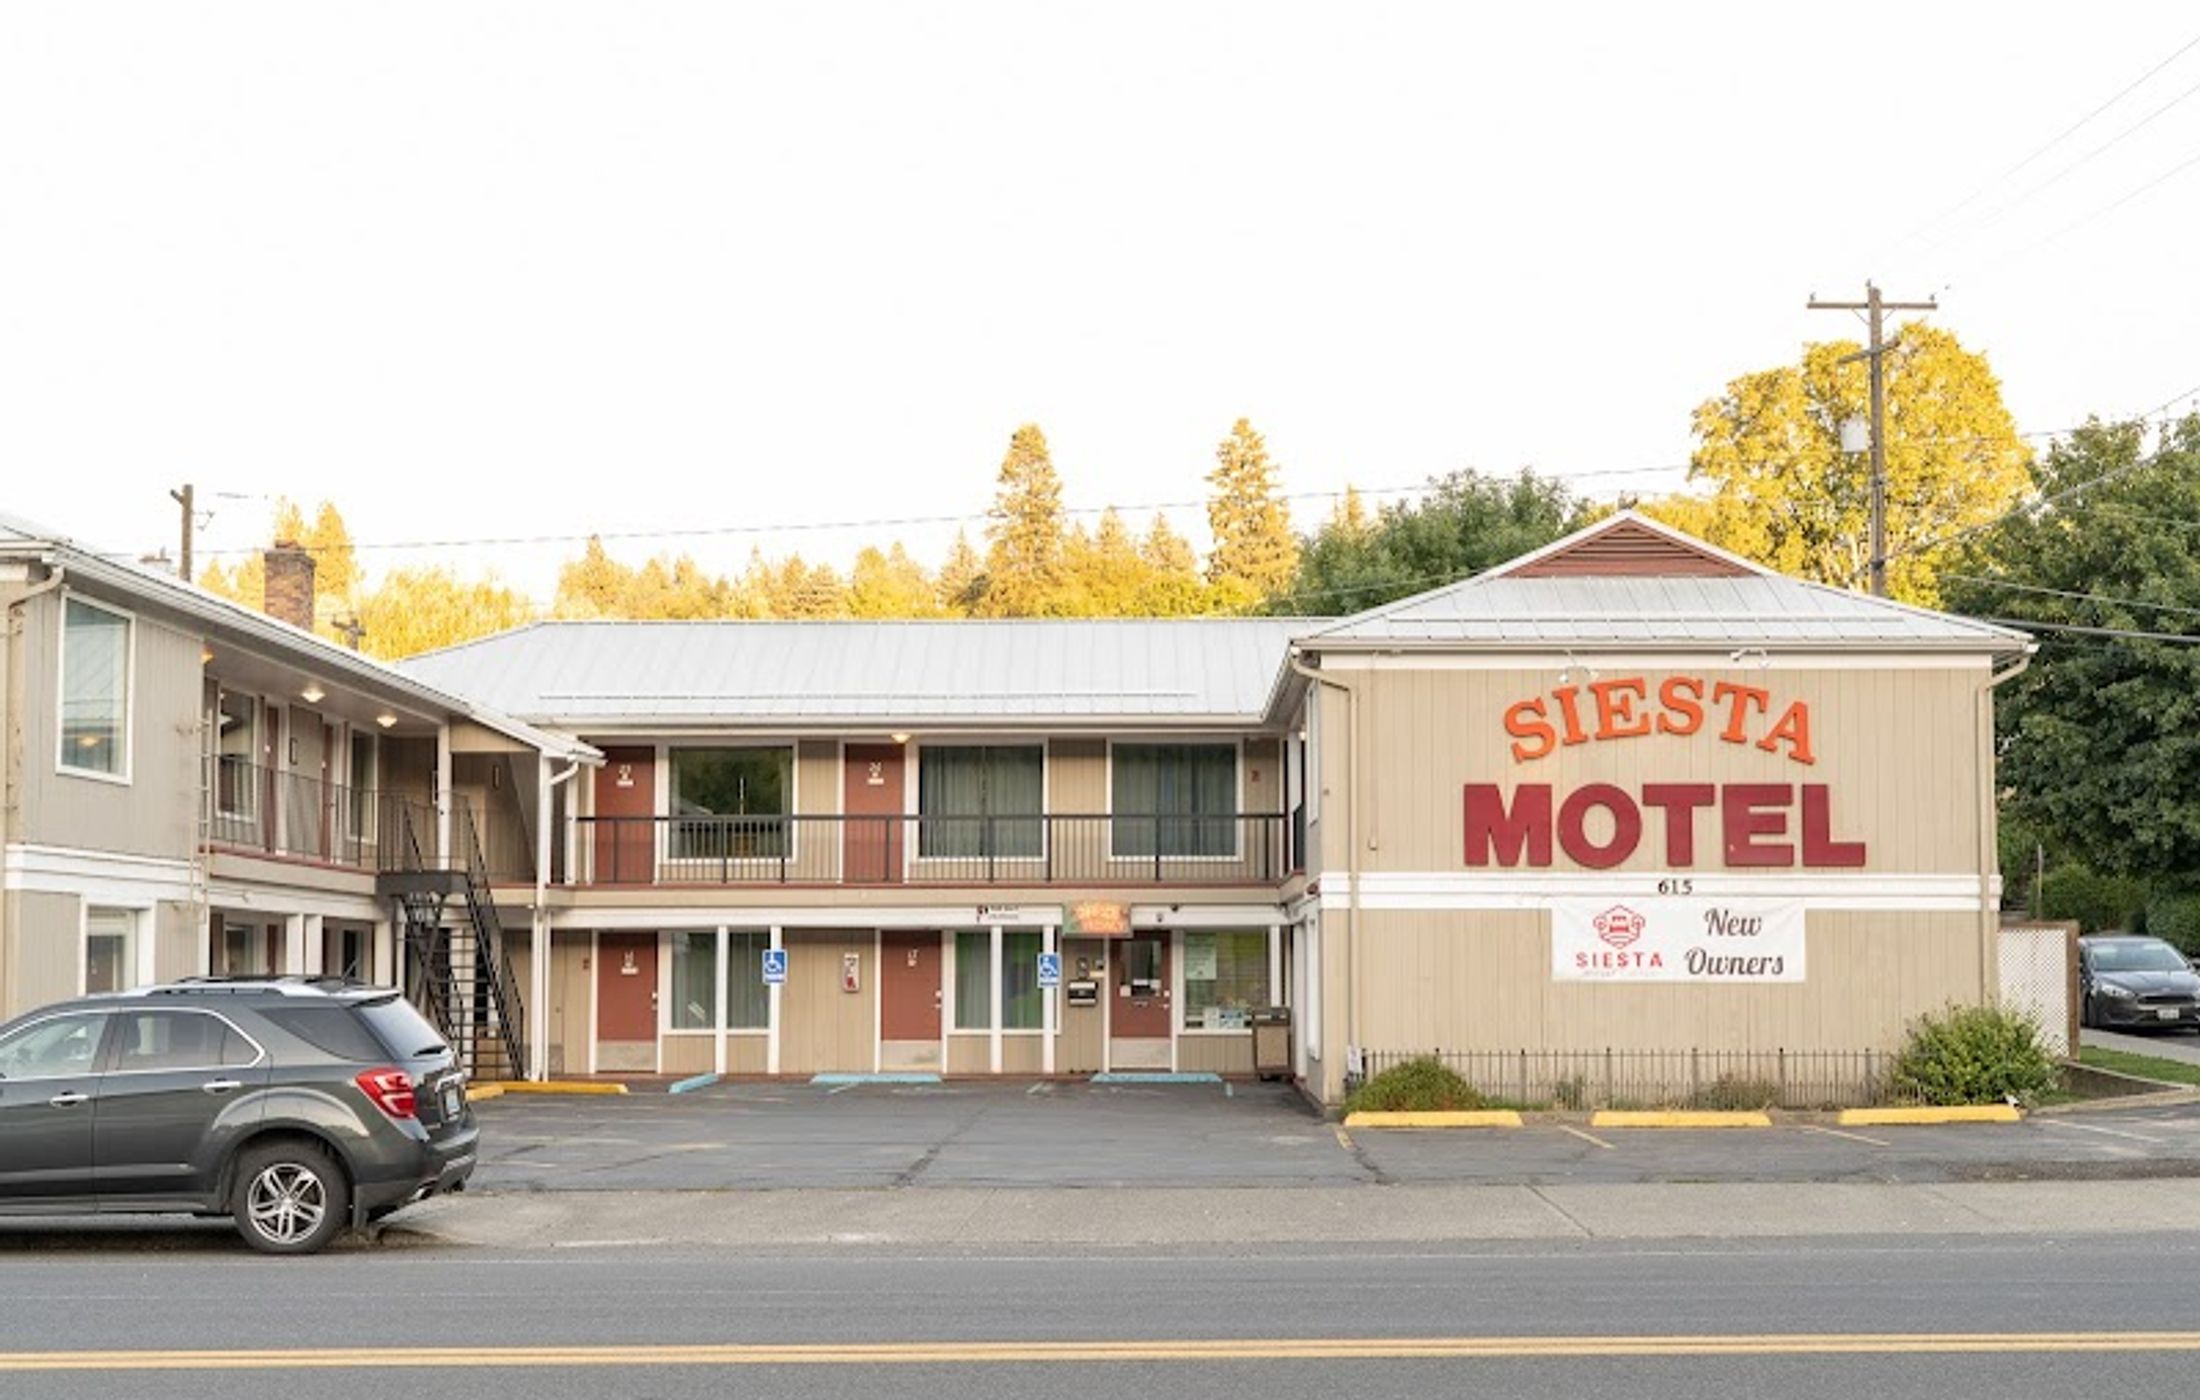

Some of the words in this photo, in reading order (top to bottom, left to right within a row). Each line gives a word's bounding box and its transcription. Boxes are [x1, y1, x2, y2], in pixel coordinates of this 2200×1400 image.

[1503, 676, 1816, 765] SIESTA
[1463, 783, 1866, 870] MOTEL
[1657, 879, 1693, 895] 615
[1704, 907, 1762, 936] New
[1576, 952, 1663, 968] SIESTA
[1684, 947, 1784, 975] Owners
